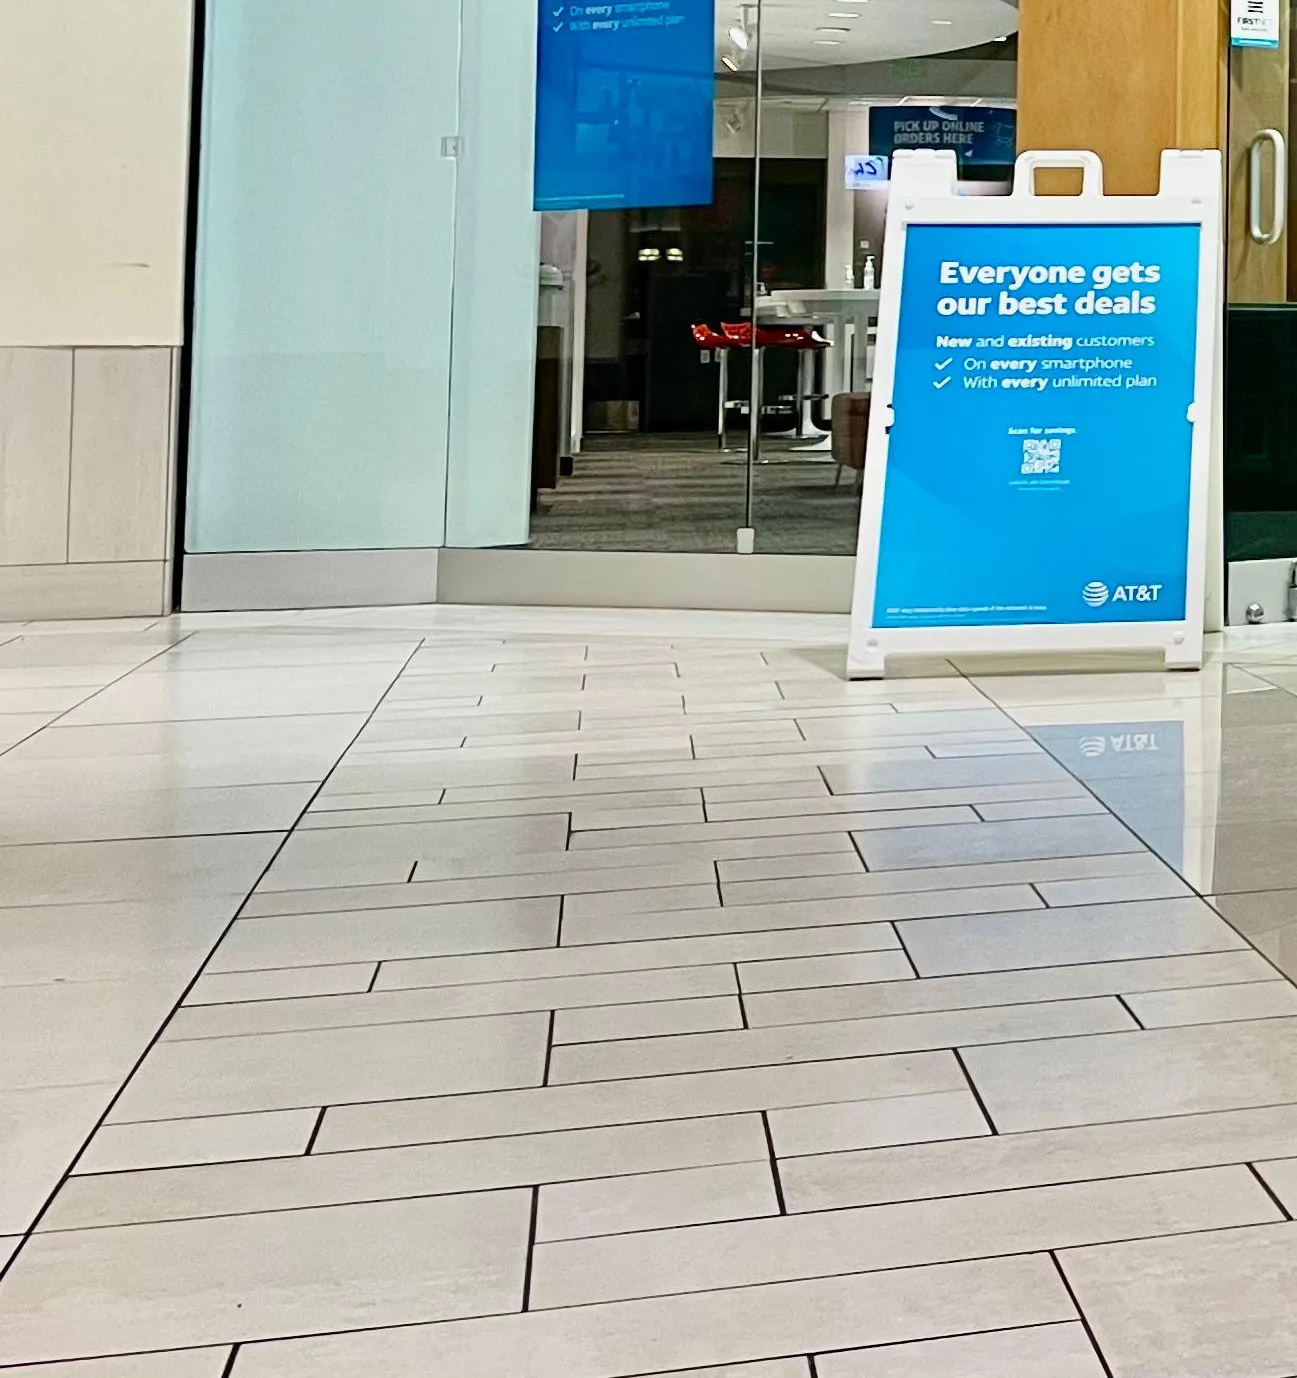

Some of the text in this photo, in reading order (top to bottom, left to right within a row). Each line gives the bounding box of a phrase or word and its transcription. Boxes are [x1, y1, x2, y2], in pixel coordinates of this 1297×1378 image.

[570, 6, 584, 16] On
[1237, 17, 1272, 26] FIRST
[893, 120, 984, 133] PICK UP ONLINE
[893, 132, 974, 144] ORDERS HERE
[940, 261, 1161, 290] Everyone gets
[937, 290, 1156, 315] our best deals
[936, 334, 1155, 350] New and existing customers
[964, 357, 1133, 373] On every smartphone
[963, 374, 1157, 391] With every unlimited plan
[1112, 584, 1162, 602] AT&T
